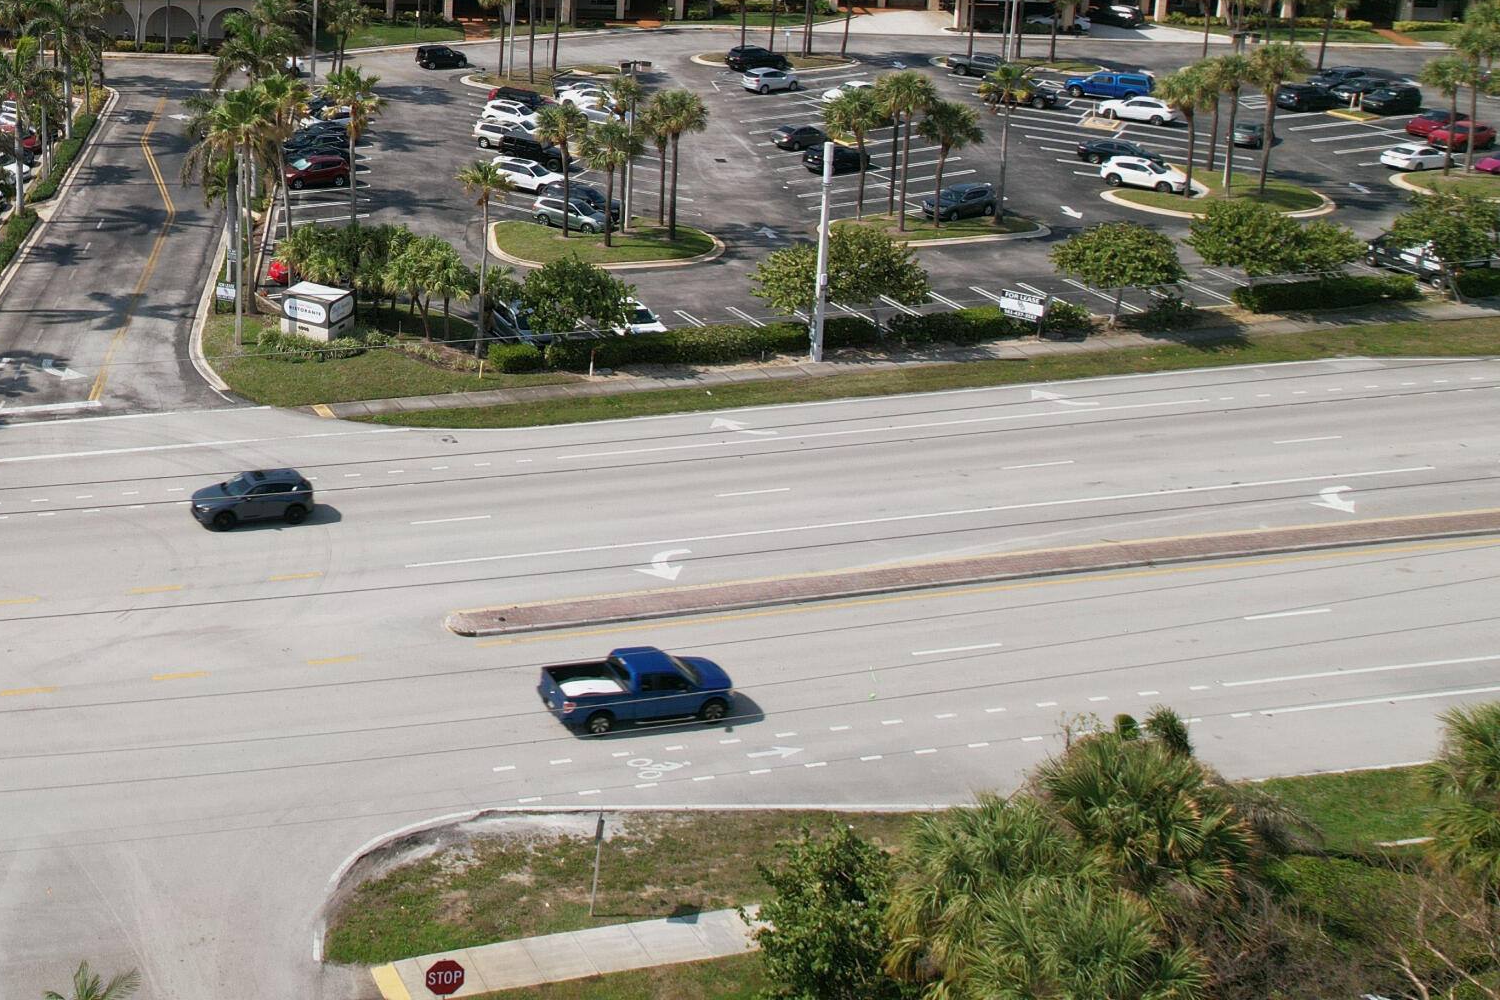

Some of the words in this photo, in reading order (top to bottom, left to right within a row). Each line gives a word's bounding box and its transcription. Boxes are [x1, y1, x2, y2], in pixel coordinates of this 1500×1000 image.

[1005, 291, 1019, 300] FOR
[1020, 294, 1040, 304] LEASE
[289, 305, 321, 317] RISTORANTE
[428, 970, 462, 985] STOP
